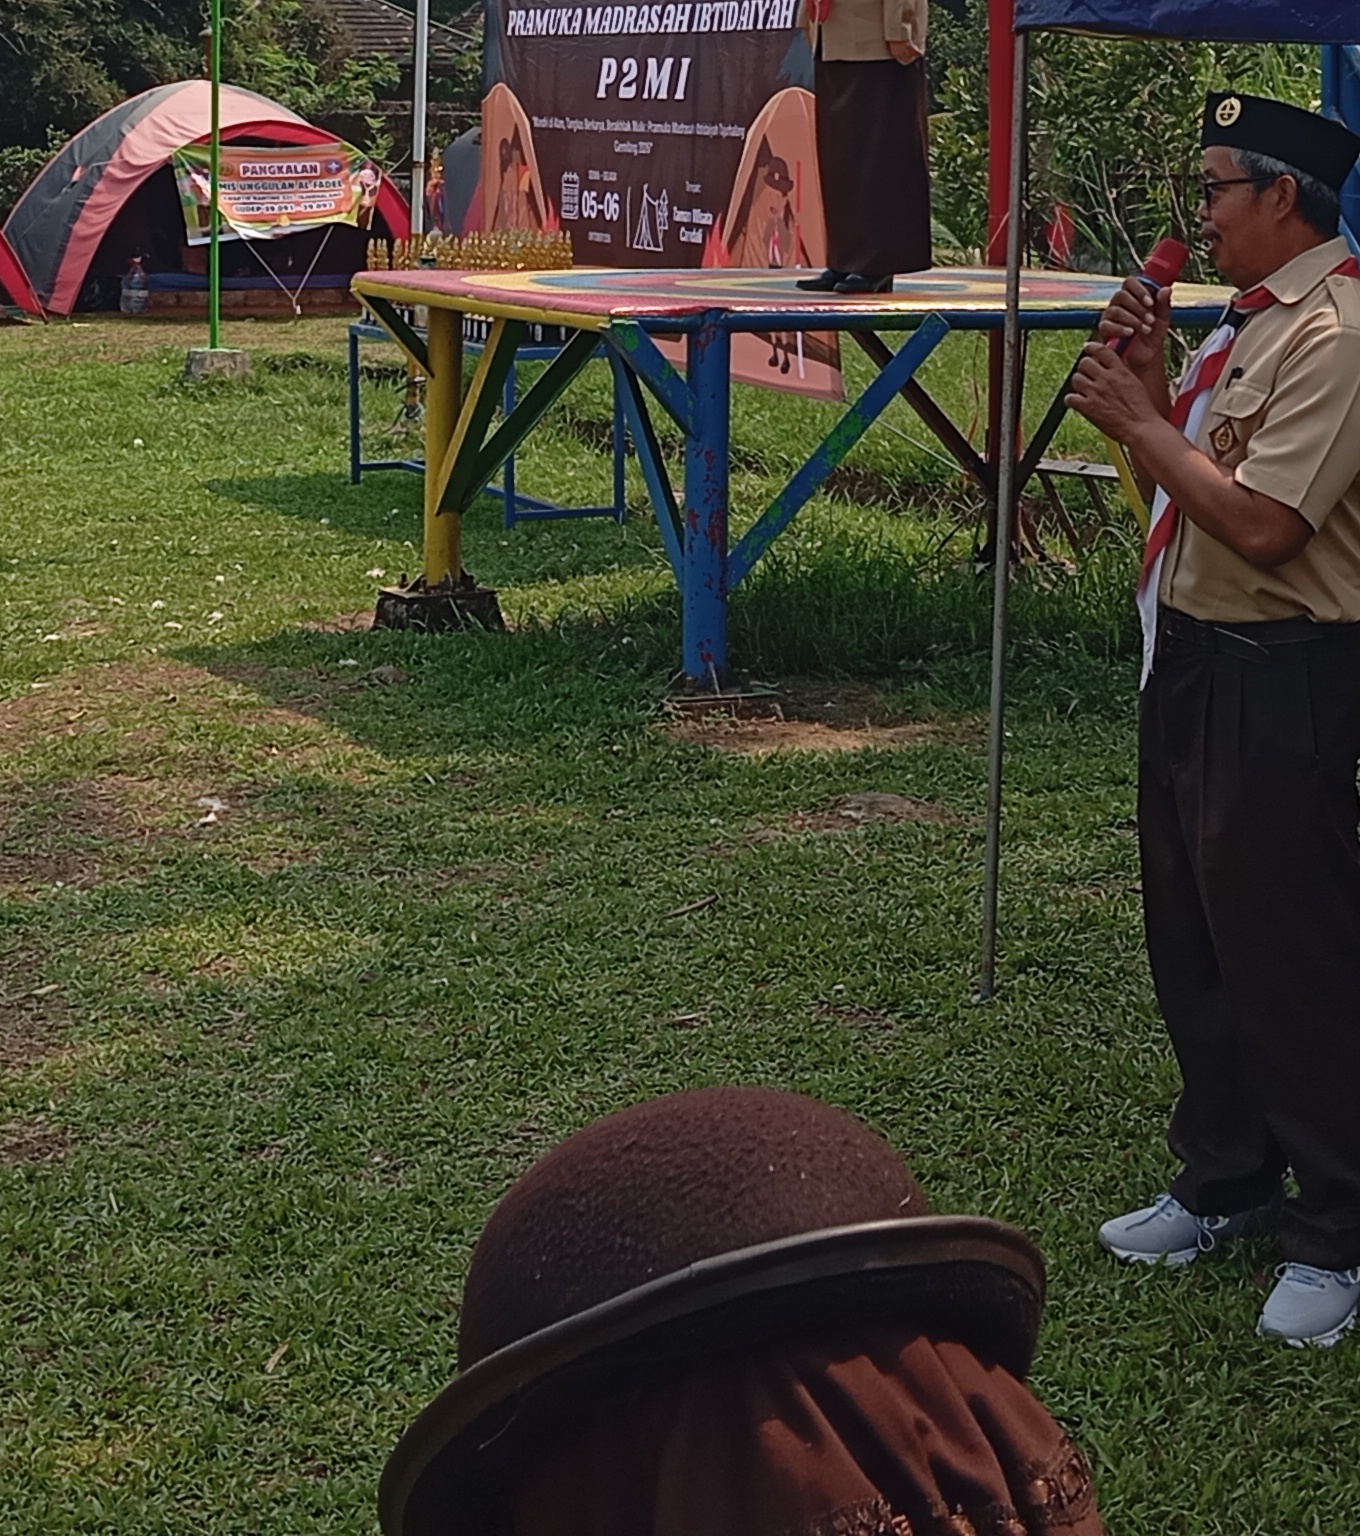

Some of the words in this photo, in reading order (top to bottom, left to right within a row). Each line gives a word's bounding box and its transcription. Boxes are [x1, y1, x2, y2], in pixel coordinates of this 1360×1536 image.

[506, 8, 583, 37] PRAMUKA
[583, 2, 691, 35] MADRASAH
[242, 164, 319, 176] PANGKALAN
[239, 182, 295, 192] UNGGULAN
[581, 190, 620, 222] 05-06
